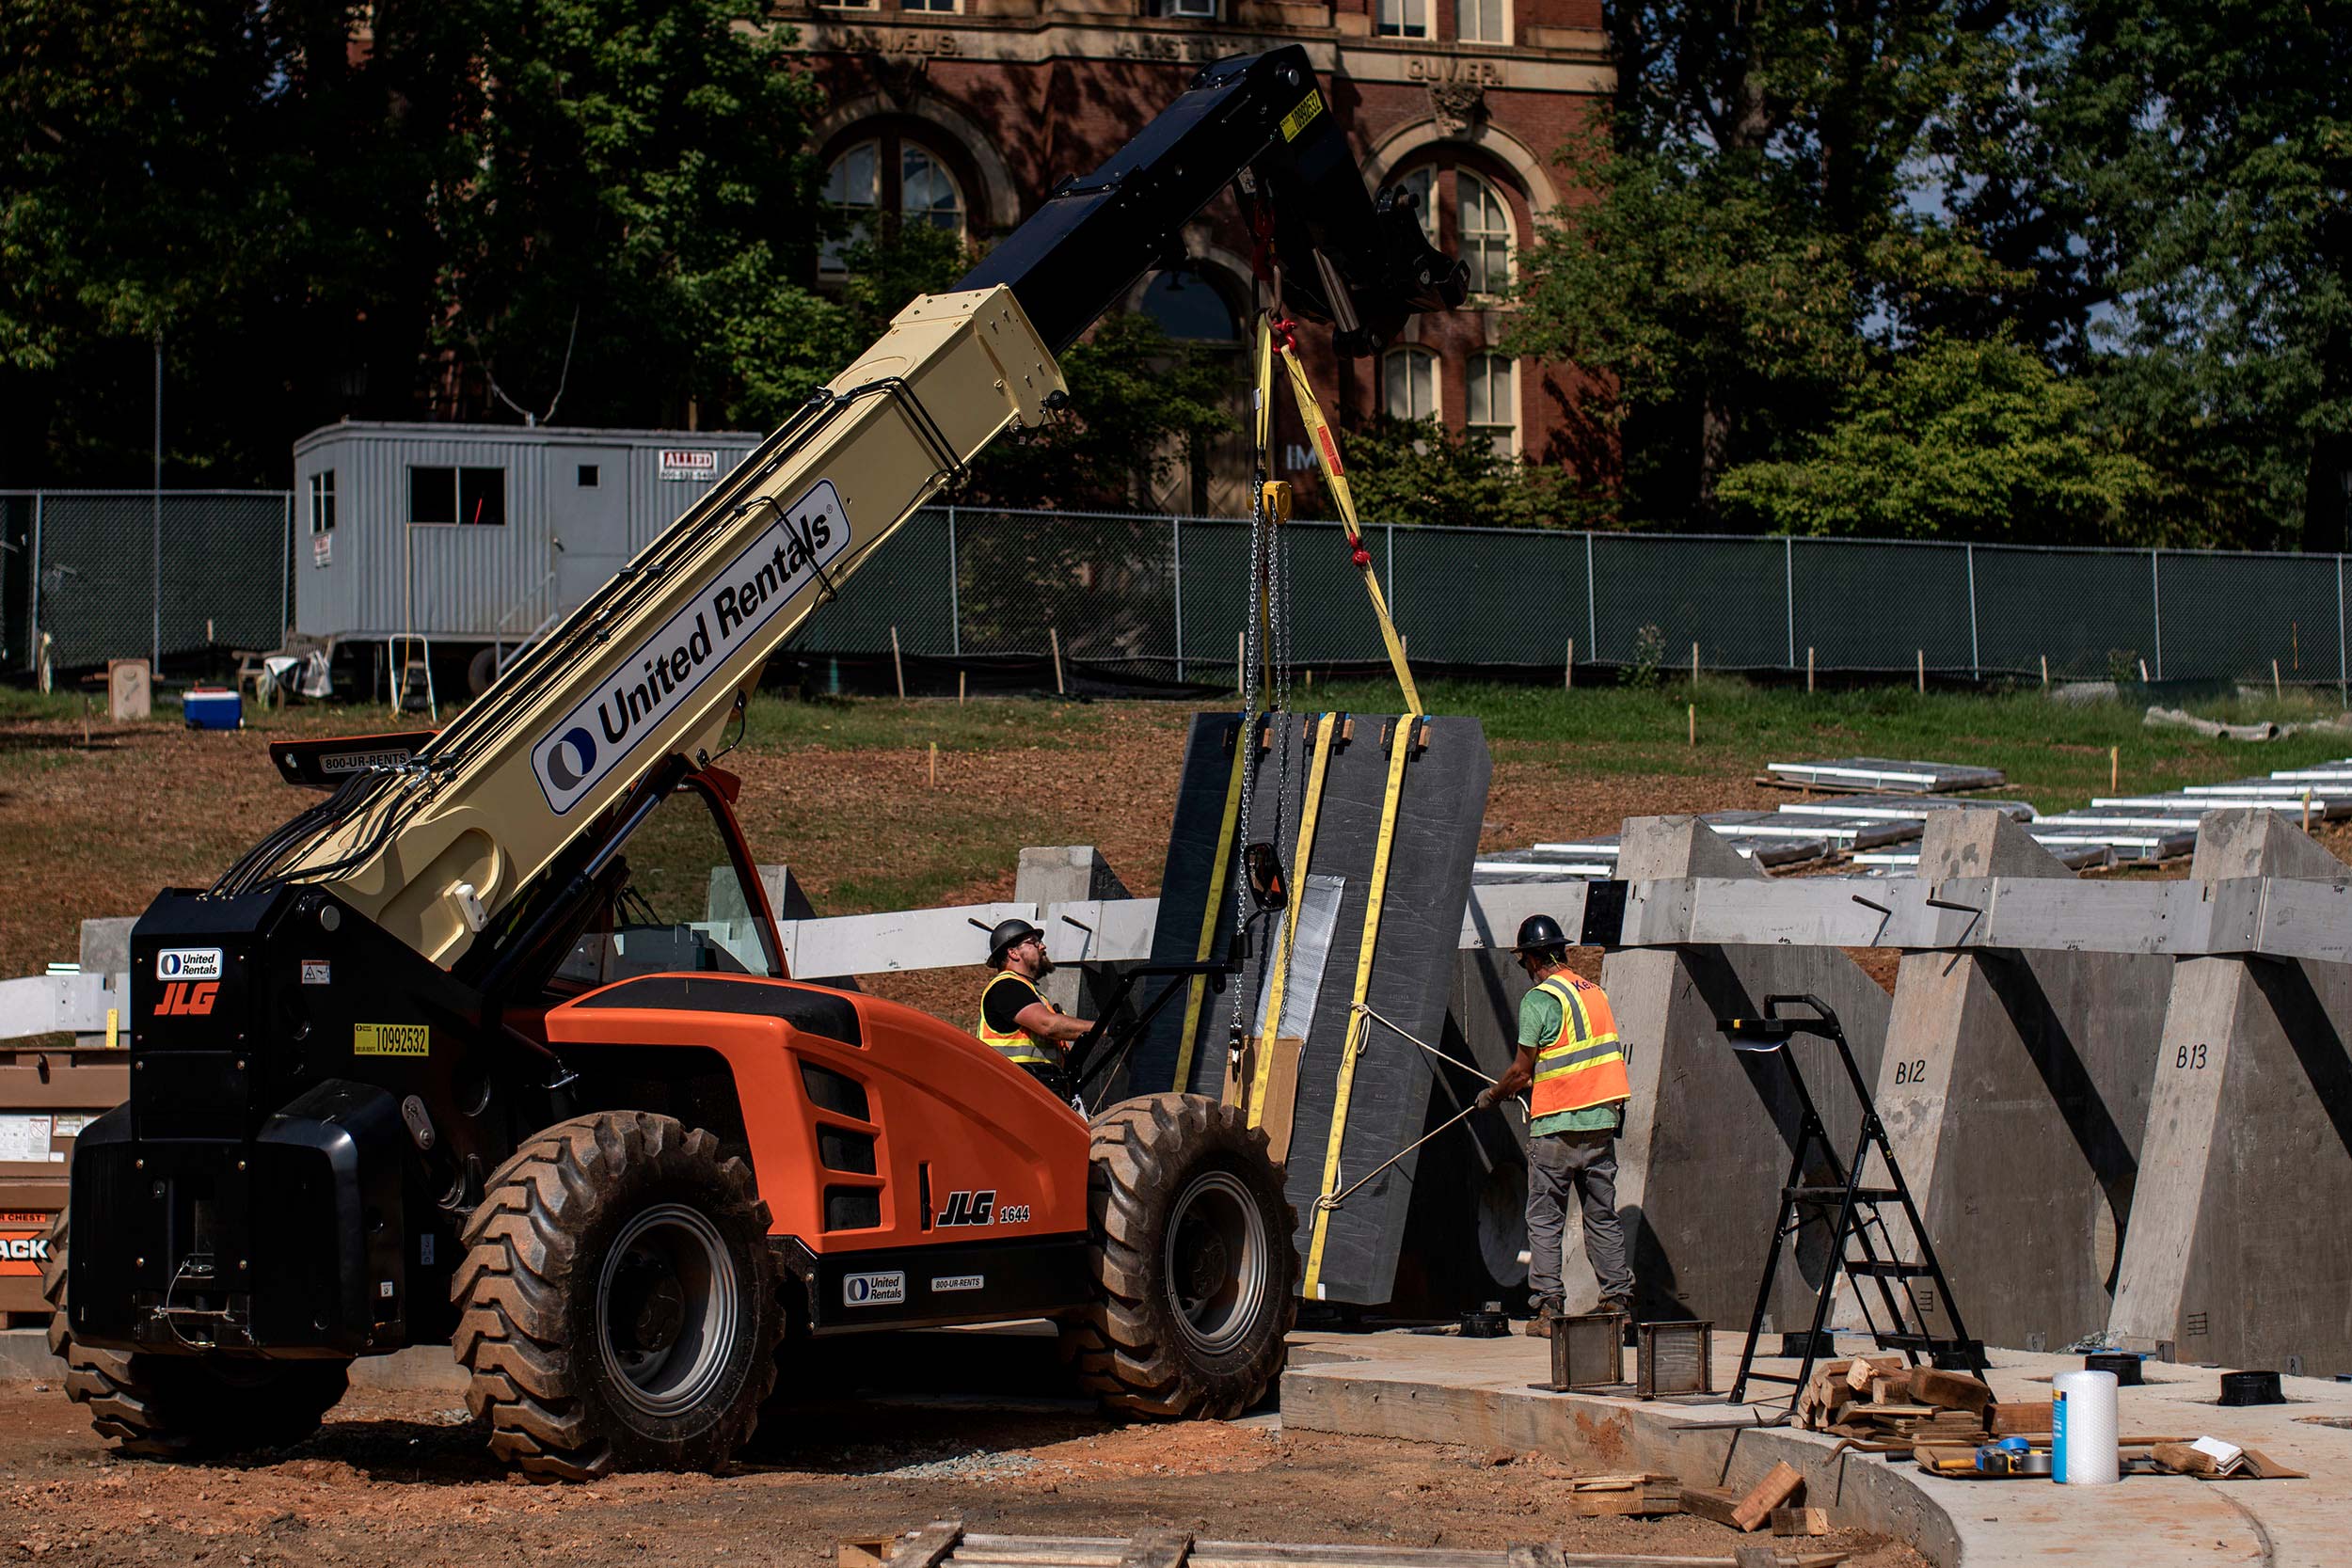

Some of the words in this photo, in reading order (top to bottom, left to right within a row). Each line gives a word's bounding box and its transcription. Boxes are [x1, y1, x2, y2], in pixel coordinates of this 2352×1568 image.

[665, 451, 712, 467] ALLIED
[596, 613, 712, 743] United
[713, 515, 832, 640] Rentals
[326, 752, 406, 768] 800-UR-RENTS
[183, 954, 215, 964] United
[183, 965, 217, 974] Rentals
[154, 982, 220, 1016] JLG
[376, 1026, 425, 1053] 10992532
[2176, 1043, 2207, 1069] B13
[1896, 1059, 1926, 1085] B12
[936, 1190, 996, 1227] JLG
[1000, 1205, 1029, 1224] 1644
[870, 1276, 900, 1288] United
[935, 1278, 980, 1289] 800-UR-RENTS
[870, 1288, 902, 1300] Rentals
